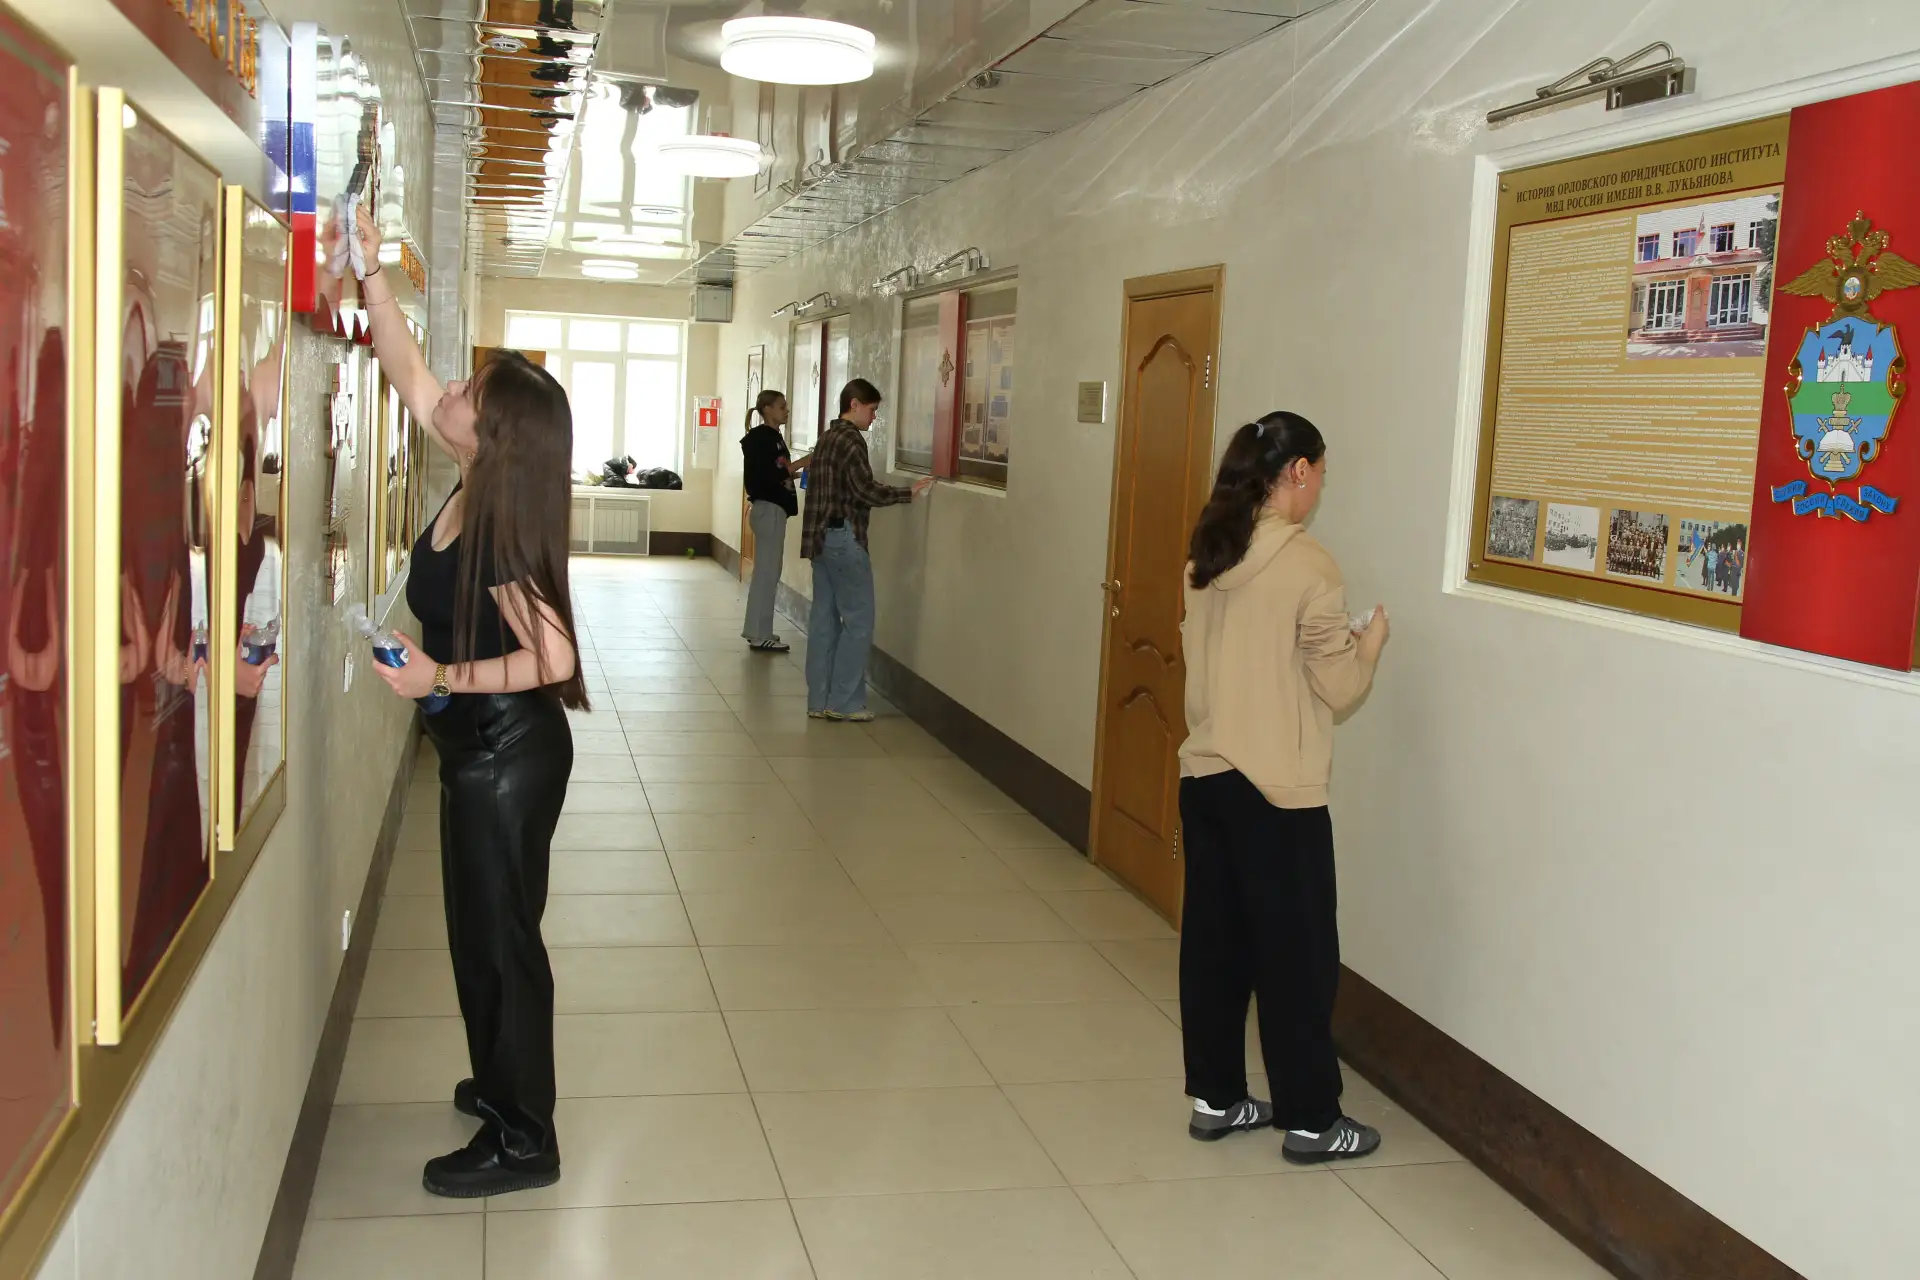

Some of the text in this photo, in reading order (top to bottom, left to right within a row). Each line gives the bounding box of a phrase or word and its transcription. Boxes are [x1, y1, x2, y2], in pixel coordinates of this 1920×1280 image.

[1516, 142, 1781, 203] ИСТОРИЯ ОРЛОВСКОГО ЮРИДИЧЕСКОГО ИНСТИТУТА
[1545, 170, 1734, 214] МВД РОССИИ ИМЕНИ В.В. ЛУКЬЯНОВА
